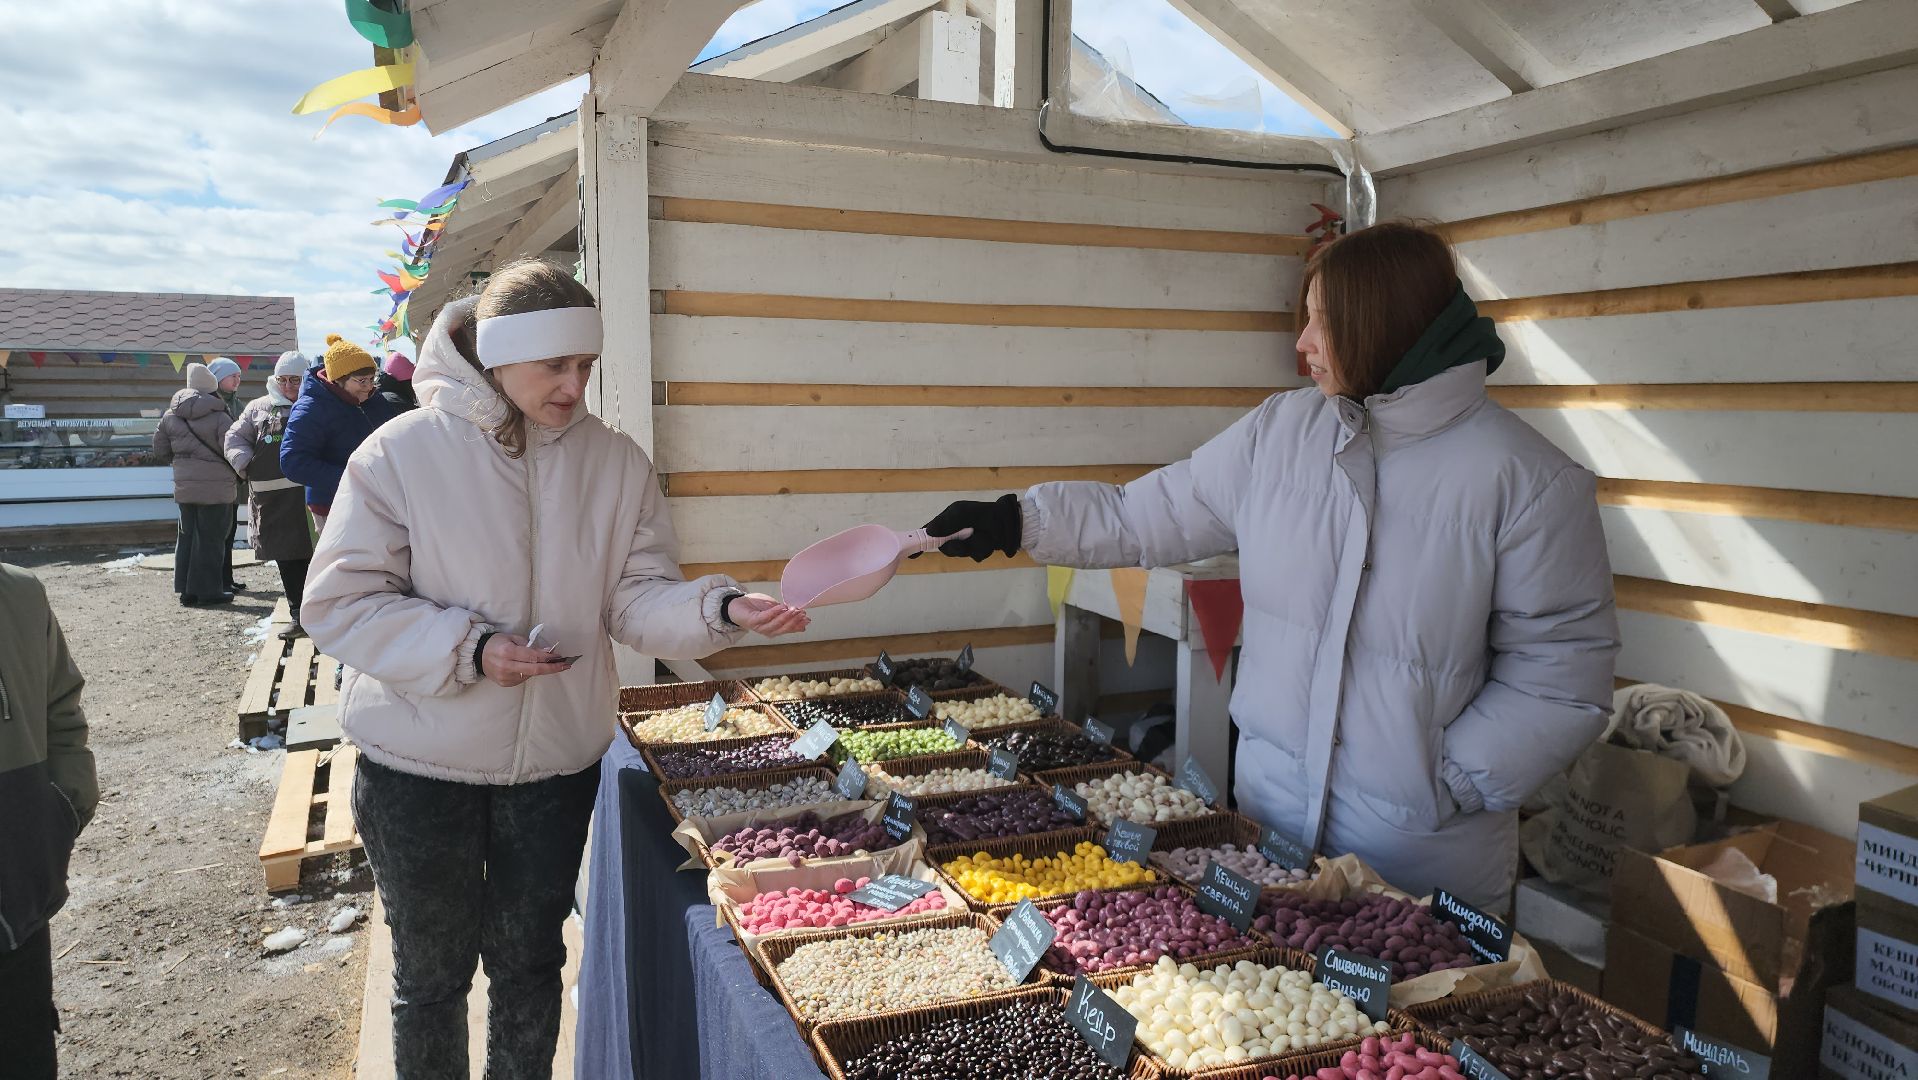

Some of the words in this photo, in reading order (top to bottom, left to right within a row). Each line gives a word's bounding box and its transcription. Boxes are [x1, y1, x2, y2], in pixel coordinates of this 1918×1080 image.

[1439, 891, 1503, 940] Миндаль
[1077, 983, 1116, 1050] Кедр
[1826, 1021, 1908, 1078] КЛЮКВА
